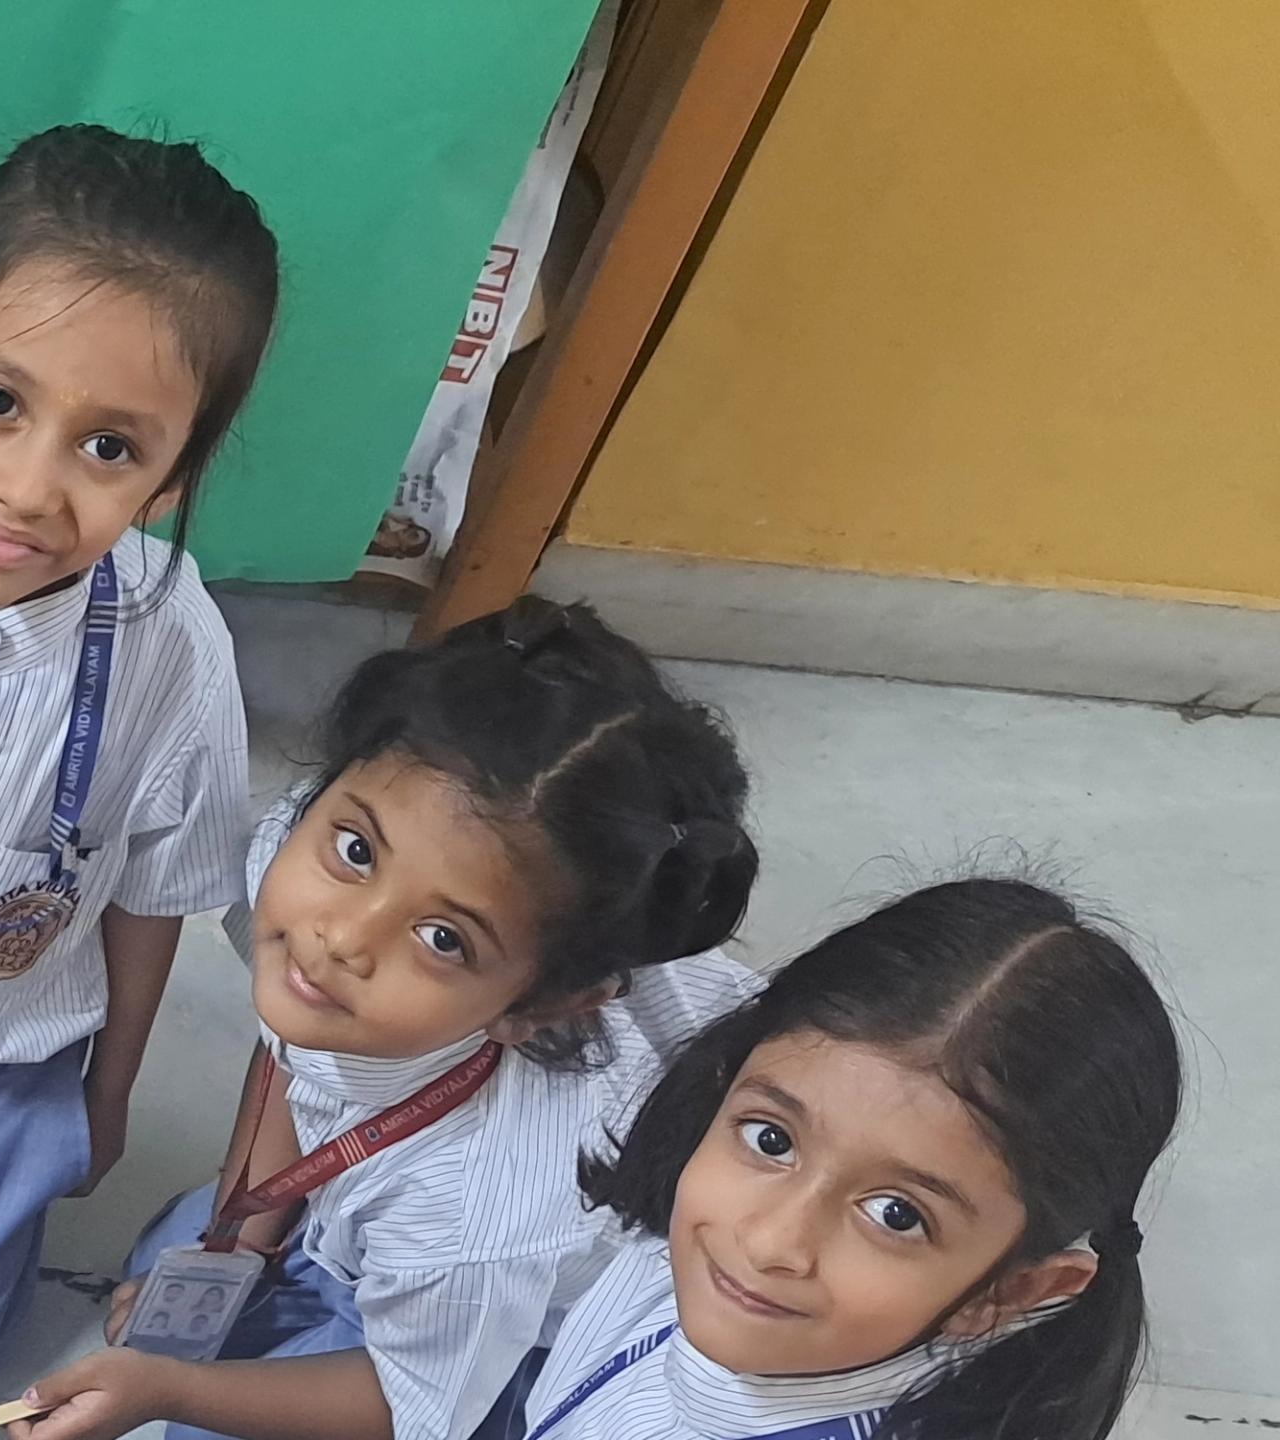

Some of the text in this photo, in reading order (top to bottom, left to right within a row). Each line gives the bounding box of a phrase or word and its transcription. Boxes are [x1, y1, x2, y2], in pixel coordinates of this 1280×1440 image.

[65, 645, 100, 791] AMRITA VIDYALAYAM
[380, 1105, 423, 1136] AMRITA
